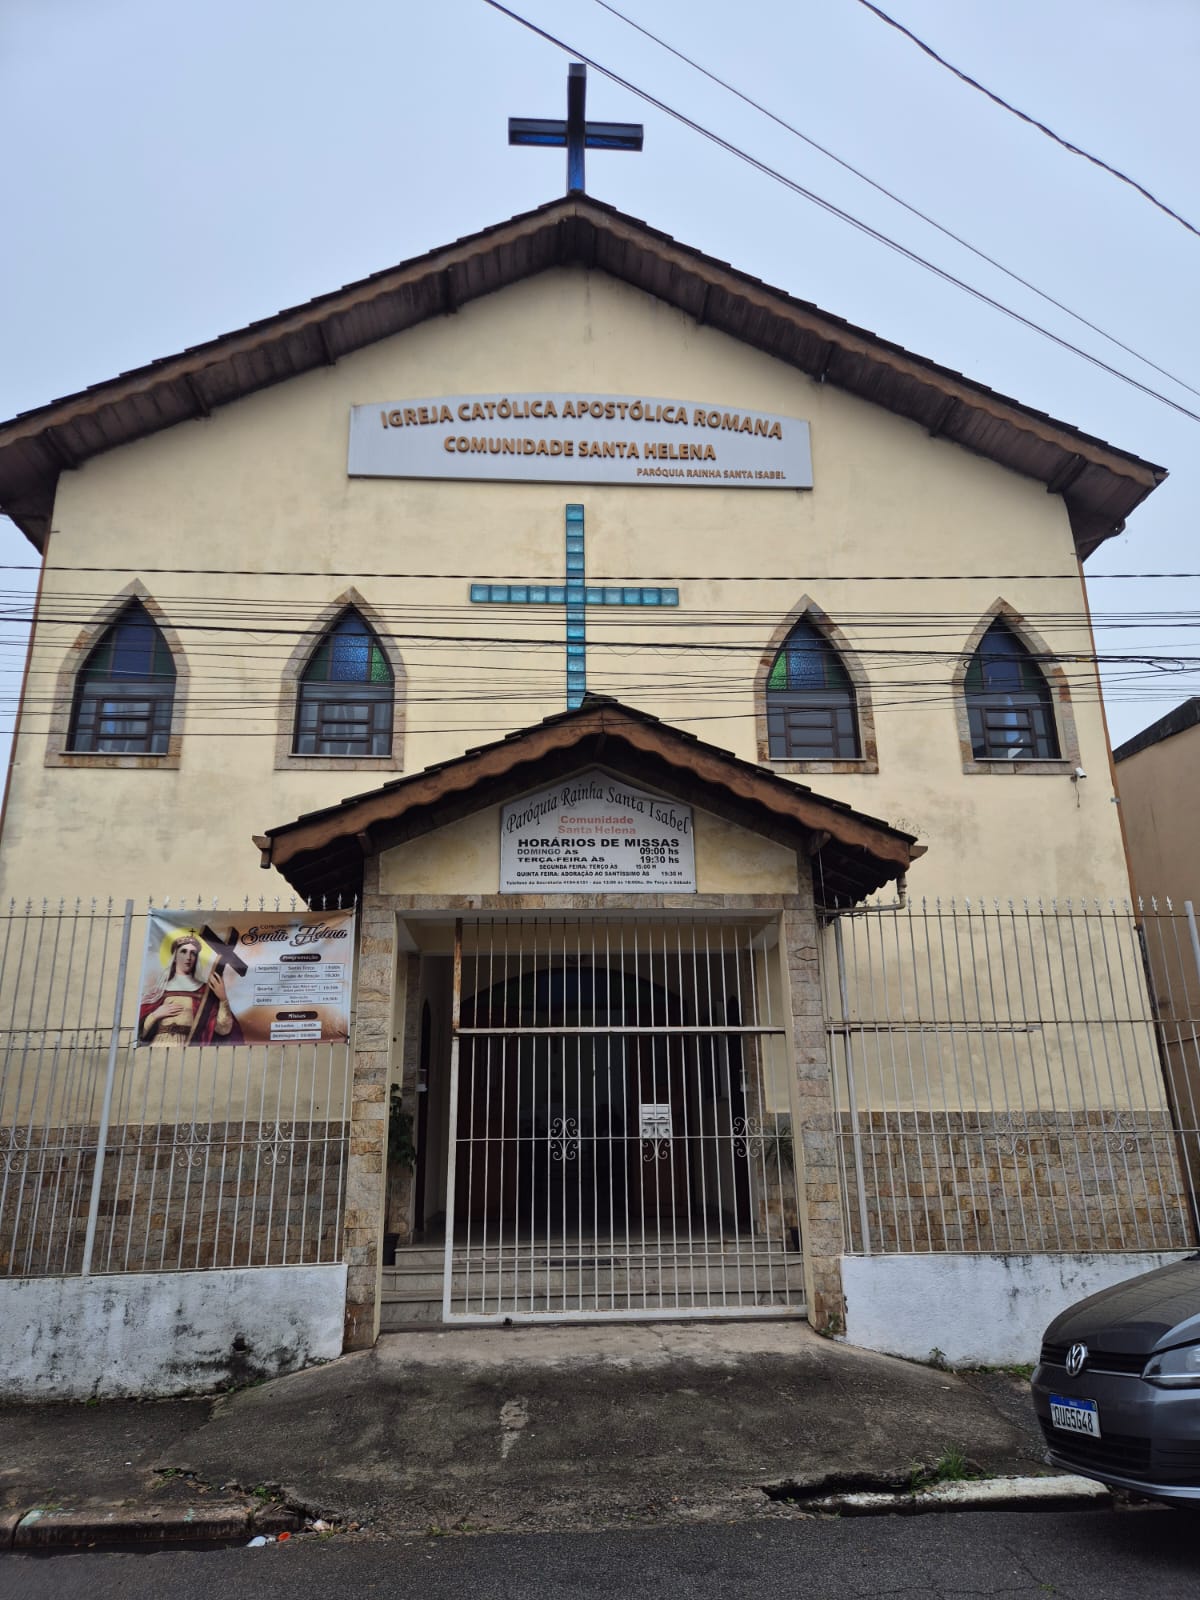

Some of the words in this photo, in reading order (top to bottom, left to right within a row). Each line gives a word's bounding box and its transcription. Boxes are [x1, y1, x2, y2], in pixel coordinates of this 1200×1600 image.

[381, 405, 454, 429] IGREJA
[457, 398, 558, 421] CATÓLICA
[562, 400, 688, 425] APOSTÓLICA
[693, 408, 783, 440] ROMANA
[444, 435, 574, 457] COMUNIDADE
[578, 440, 639, 459] SANTA
[644, 442, 716, 461] HELENA
[636, 467, 685, 478] PARÓQUIA
[687, 469, 721, 479] RAINHA
[723, 470, 753, 479] SANTA
[754, 471, 786, 480] ISABEL
[506, 792, 558, 834] Paróquia
[560, 781, 604, 808] Rainha
[606, 786, 645, 814] Santa
[649, 801, 690, 835] Isabel
[560, 815, 634, 825] Comunidade
[558, 825, 592, 834] Santa
[594, 825, 636, 835] Helena
[518, 836, 596, 848] HORÁRIOS
[600, 838, 620, 847] DE
[624, 838, 680, 847] MISSAS
[639, 847, 666, 855] 09:00
[668, 847, 679, 855] hs
[640, 855, 666, 864] 19:30
[668, 855, 680, 864] hs
[241, 926, 290, 946] Santa
[289, 922, 348, 947] Helena
